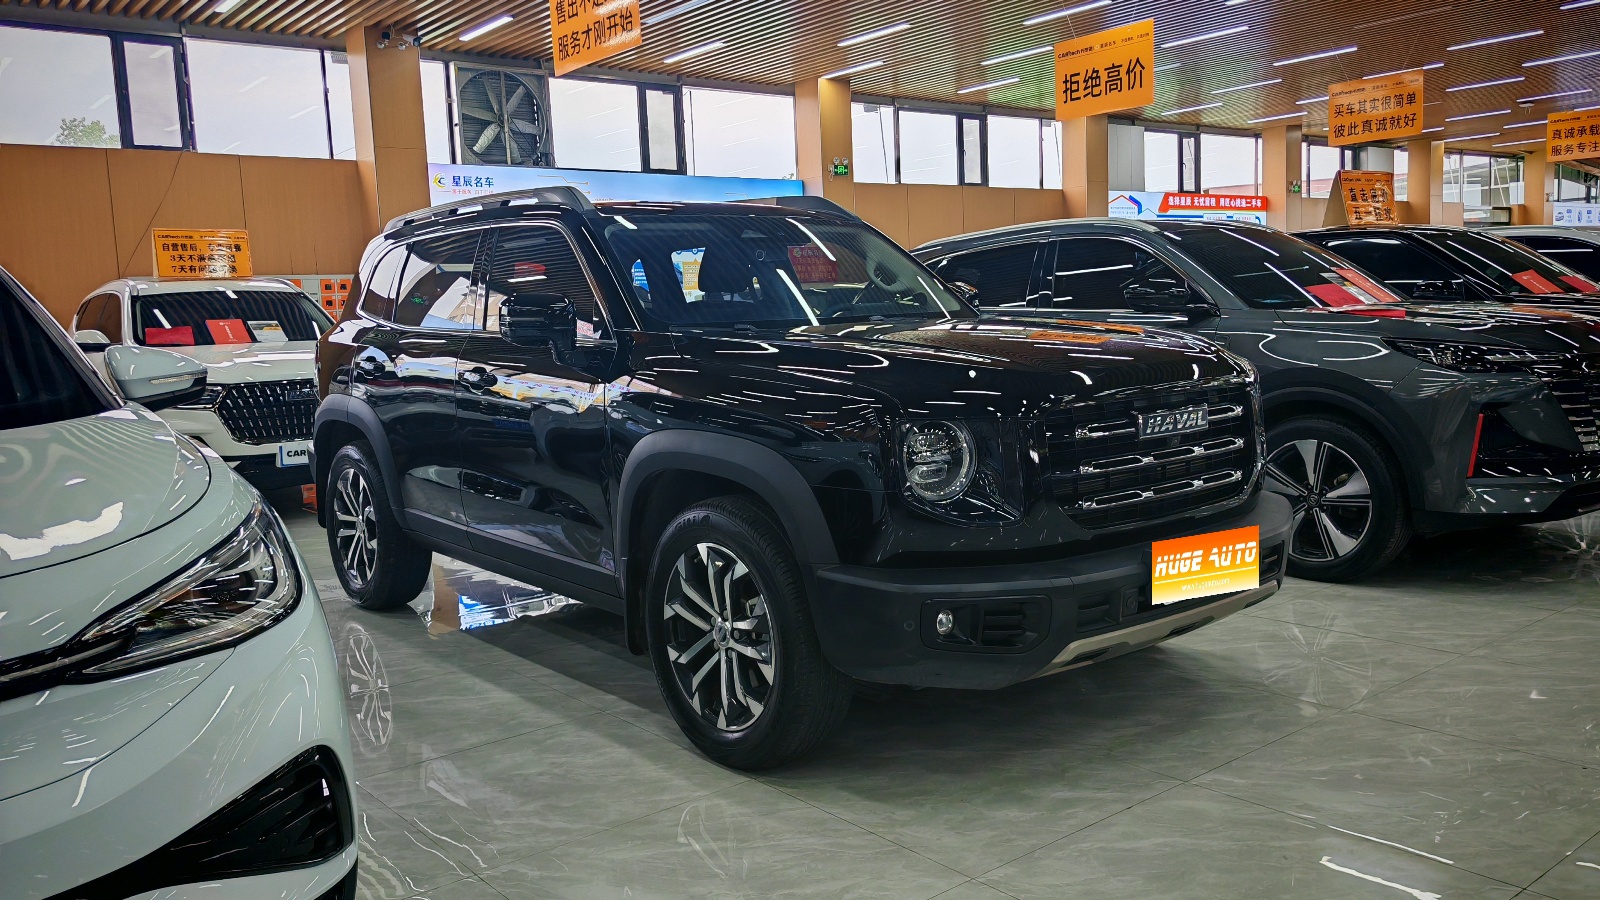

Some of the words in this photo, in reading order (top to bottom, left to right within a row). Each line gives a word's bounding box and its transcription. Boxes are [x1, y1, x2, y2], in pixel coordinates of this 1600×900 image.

[558, 7, 633, 61] 服务才刚开始
[1062, 57, 1146, 104] 拒绝高价
[1334, 91, 1417, 118] 买车其实很简单
[1333, 113, 1418, 138] 彼此真诚就好
[1551, 124, 1600, 140] 真诚承载
[1551, 141, 1600, 156] 服务专注
[452, 175, 495, 188] 星辰名车
[1145, 410, 1207, 434] HAVAL
